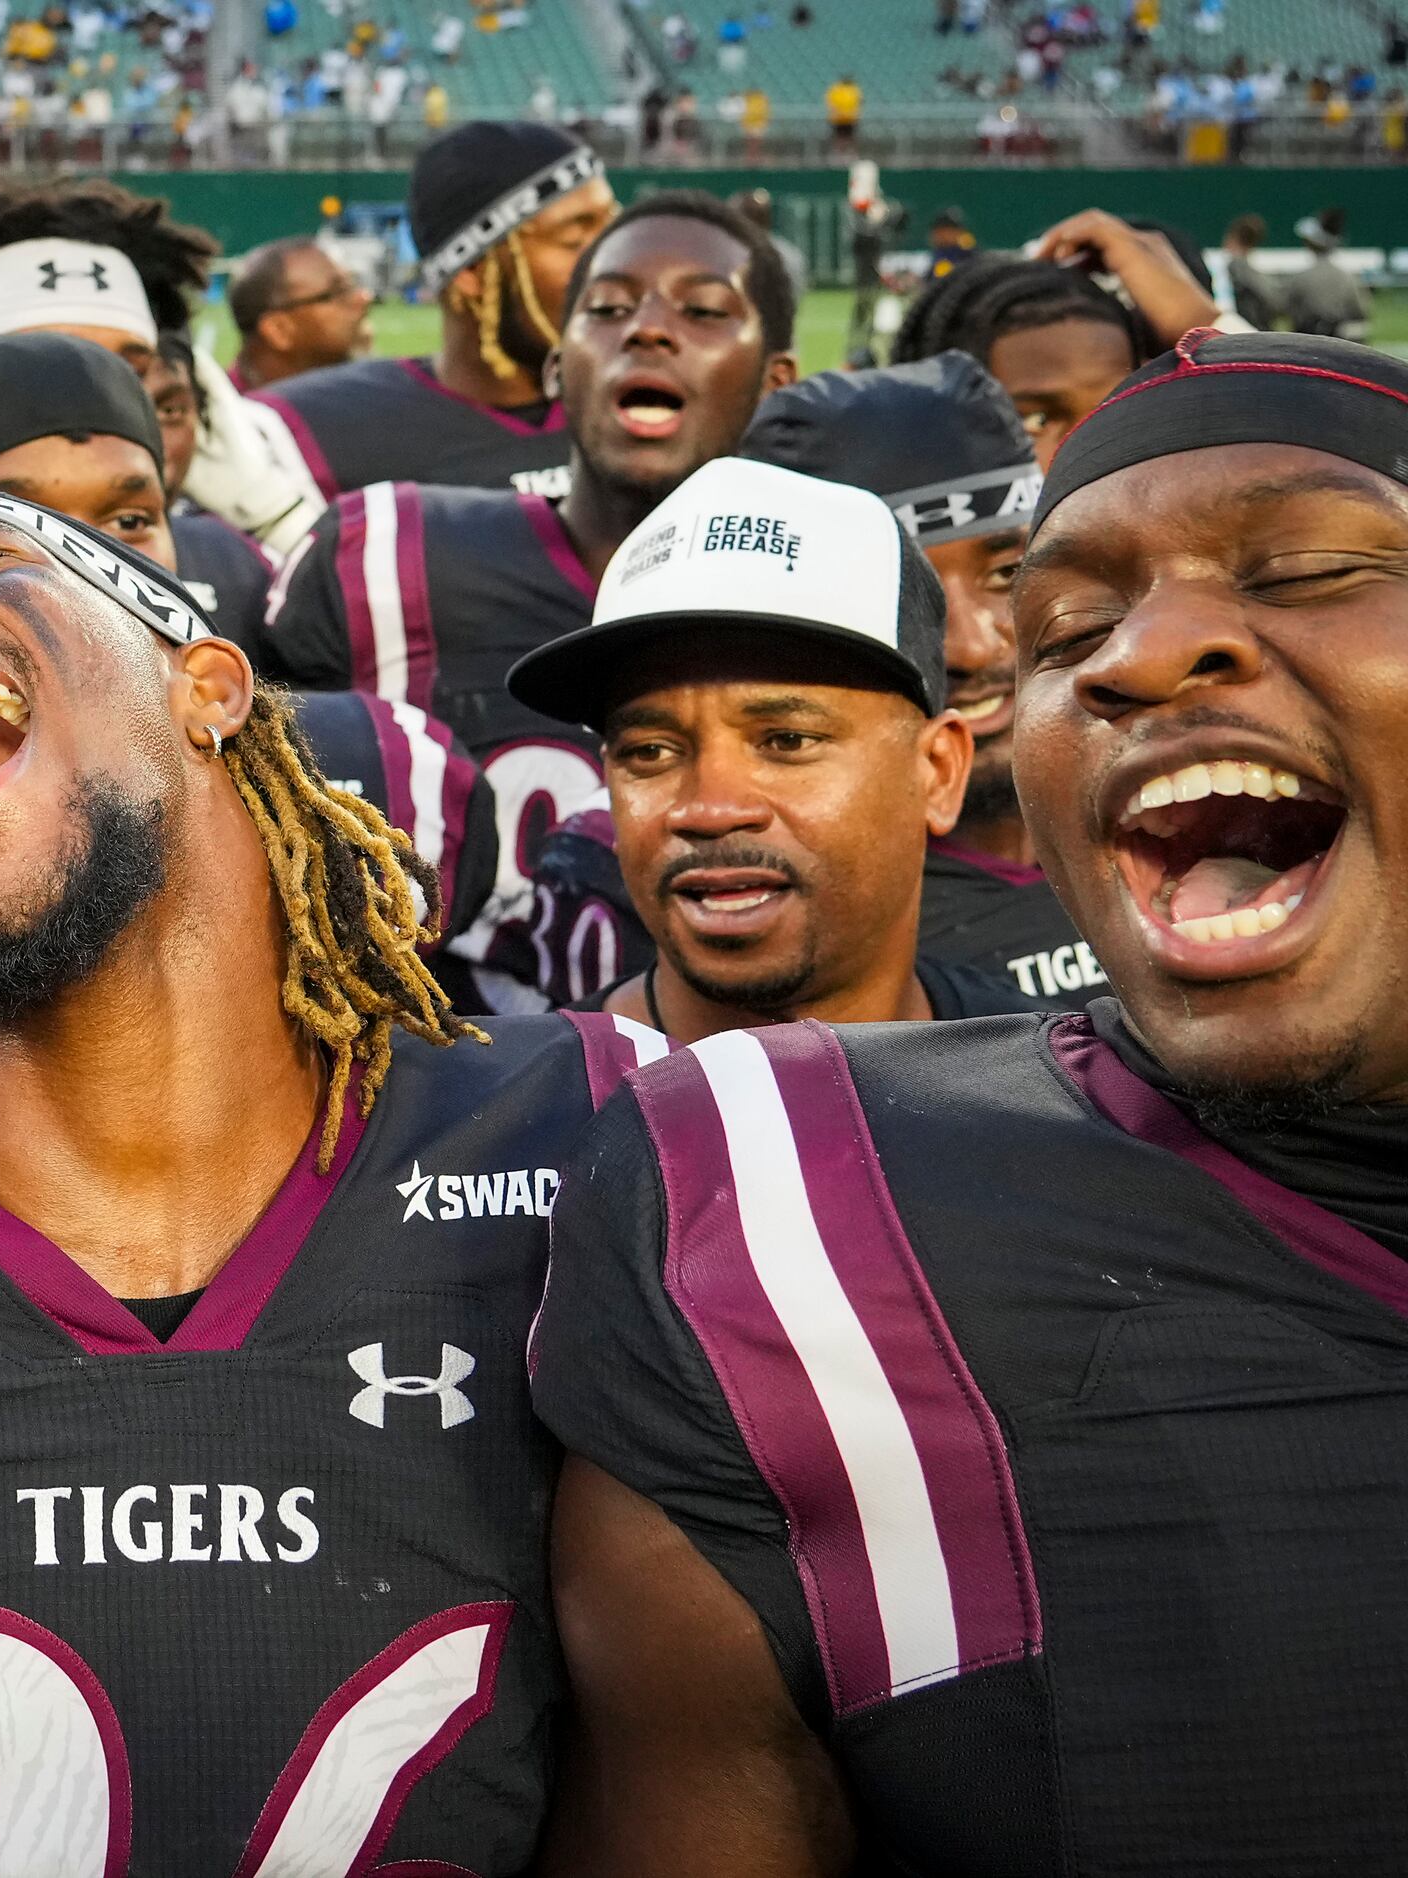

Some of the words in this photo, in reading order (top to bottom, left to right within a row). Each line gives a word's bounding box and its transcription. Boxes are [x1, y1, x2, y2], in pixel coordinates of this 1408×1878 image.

[704, 533, 801, 559] GREASE
[708, 515, 787, 537] CEASE
[437, 1167, 560, 1221] SWAC
[16, 1484, 321, 1565] TIGERS
